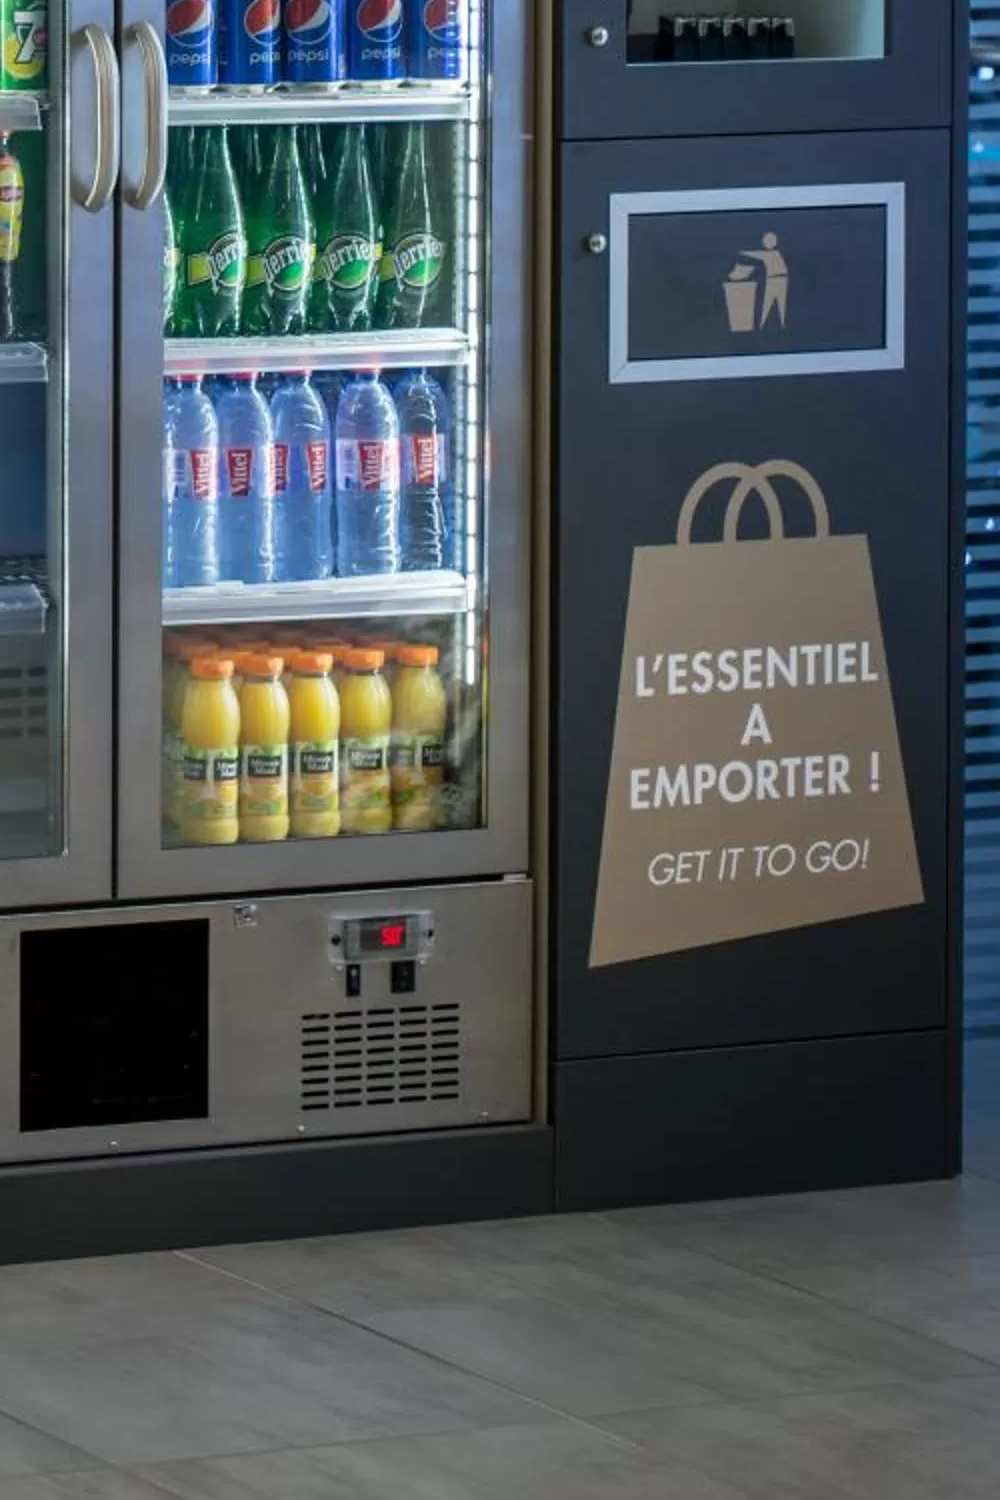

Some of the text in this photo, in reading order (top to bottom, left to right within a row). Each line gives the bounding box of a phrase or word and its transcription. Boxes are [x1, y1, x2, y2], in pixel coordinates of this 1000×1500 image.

[288, 48, 329, 64] pepsi
[231, 452, 248, 493] Vittel
[418, 438, 435, 479] Vittel
[634, 641, 879, 698] L'ESSENTIEL
[740, 702, 773, 746] A
[629, 753, 852, 811] EMPORTER
[647, 837, 871, 886] GET IT TO GO!
